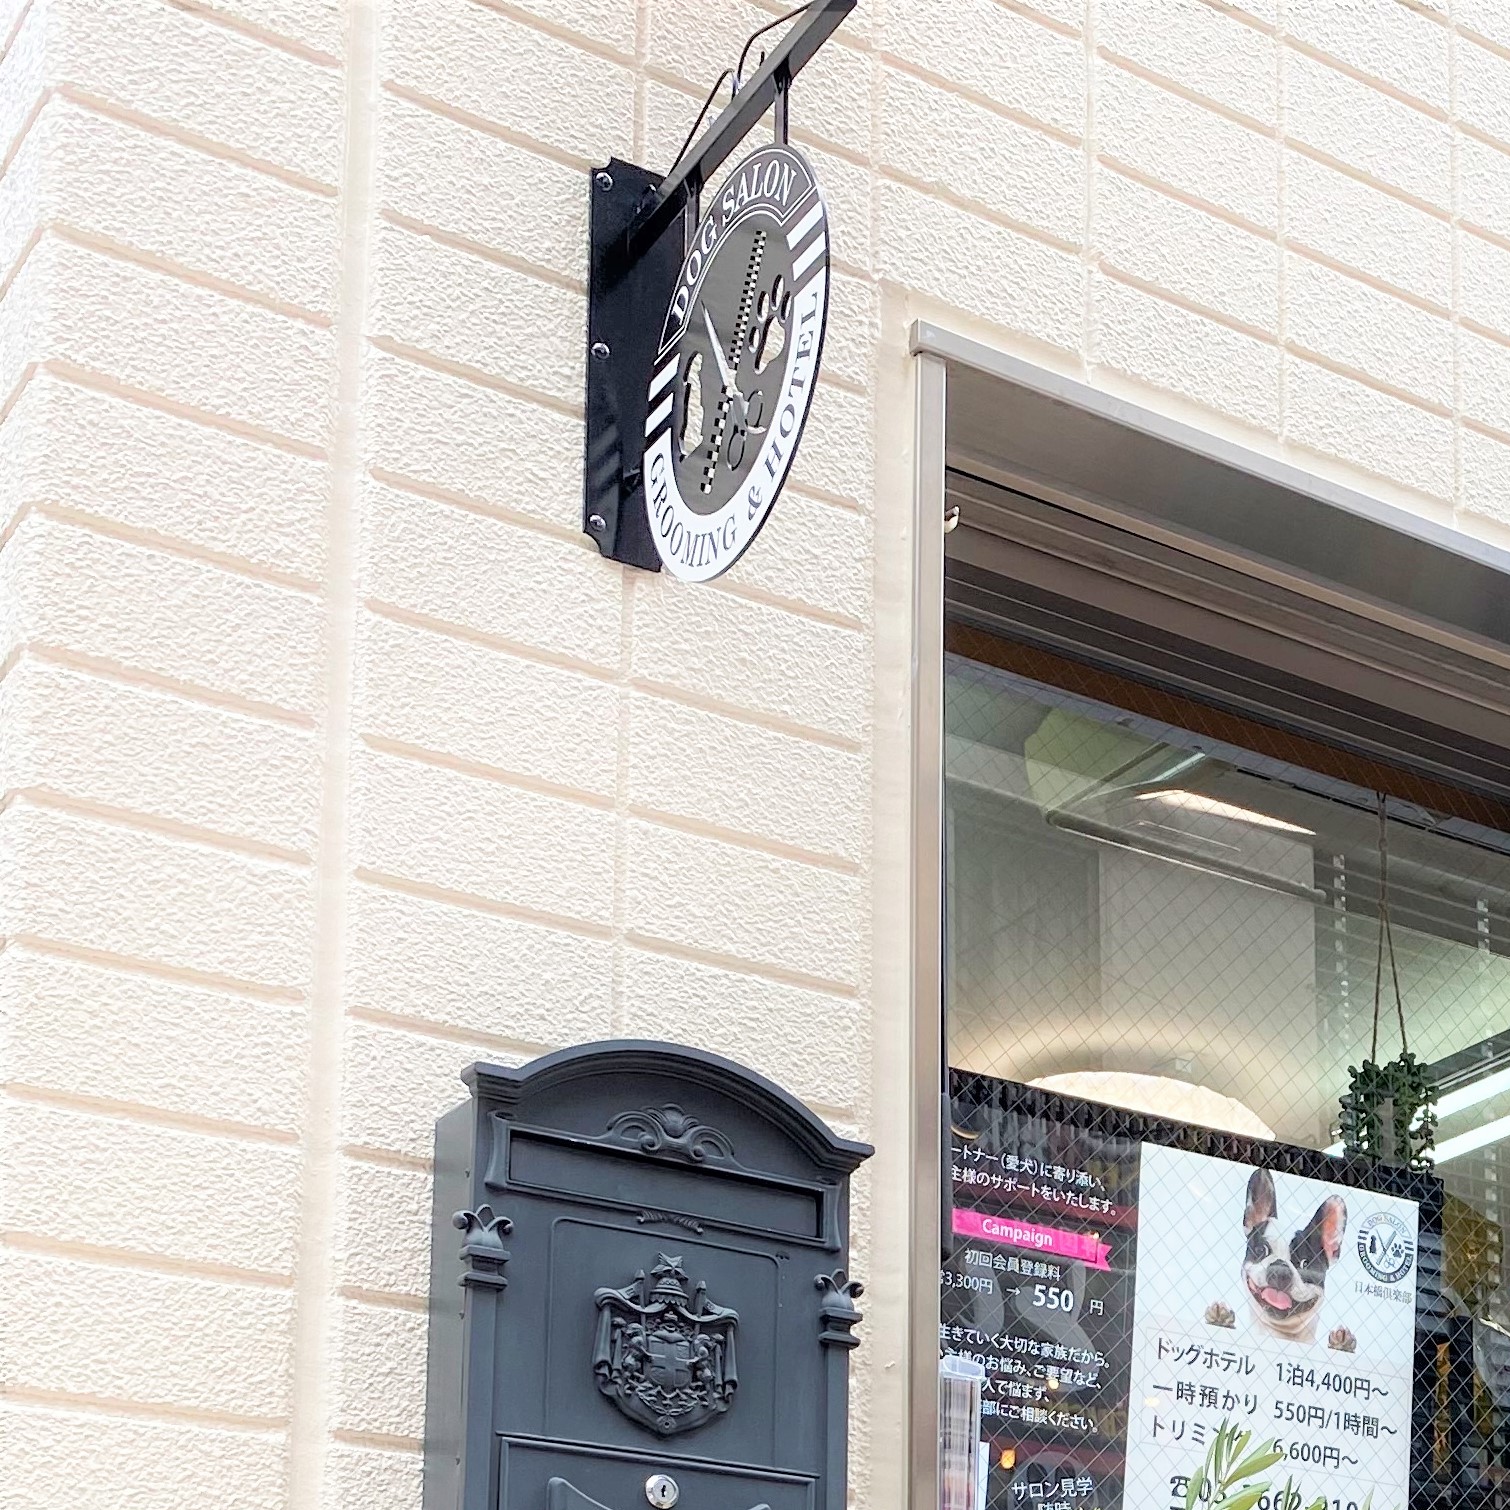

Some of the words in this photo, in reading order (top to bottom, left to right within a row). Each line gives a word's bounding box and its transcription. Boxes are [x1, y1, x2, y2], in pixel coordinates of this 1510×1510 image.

[671, 215, 718, 326] DOG
[722, 159, 797, 227] SALON
[650, 452, 738, 568] GROOMING
[747, 485, 763, 521] &
[763, 291, 818, 480] HOTEL
[982, 1218, 1053, 1248] Campaign
[964, 1248, 1061, 1281] 初回会員登録料
[1032, 1283, 1074, 1312] 550
[1090, 1299, 1105, 1316] 円
[1157, 1336, 1256, 1376] ドッグホテル
[1152, 1380, 1259, 1415] 一時預かり
[1012, 1478, 1094, 1501] サロン見学
